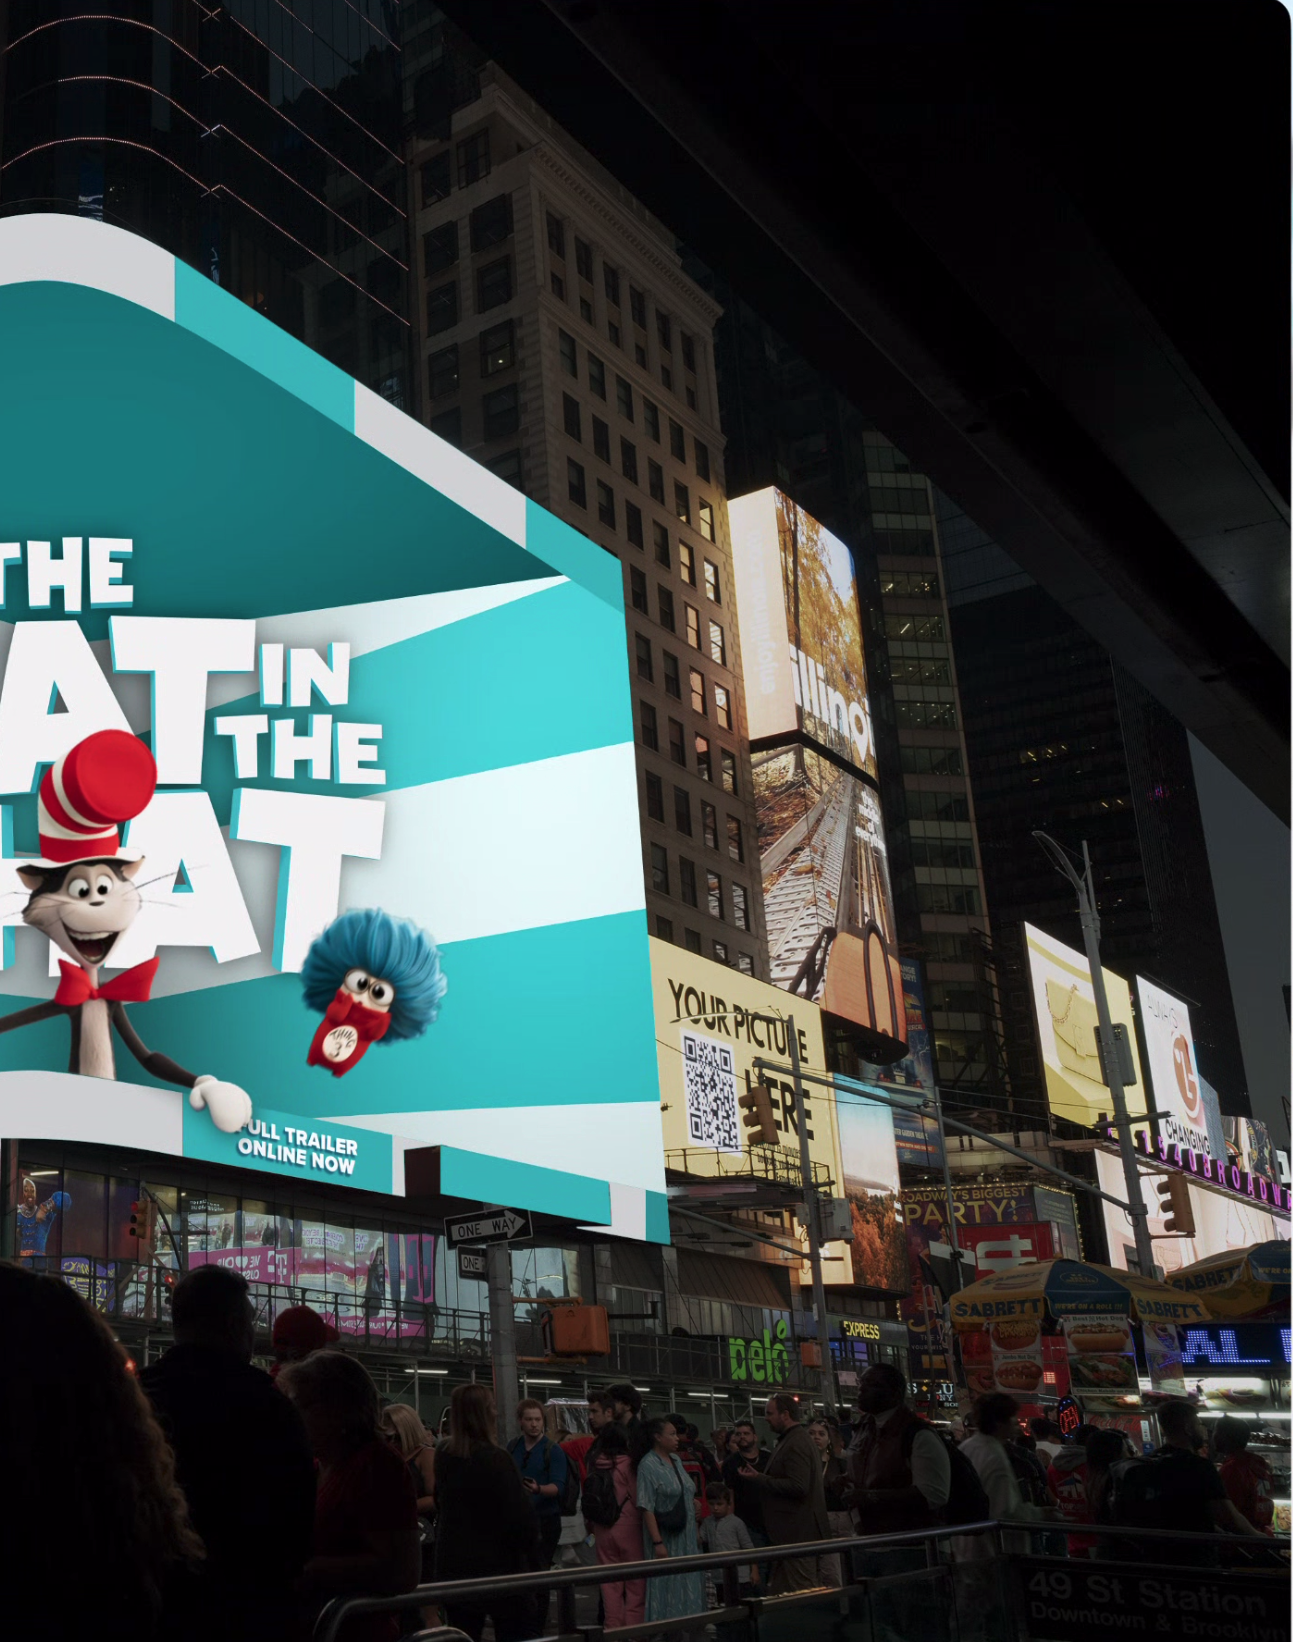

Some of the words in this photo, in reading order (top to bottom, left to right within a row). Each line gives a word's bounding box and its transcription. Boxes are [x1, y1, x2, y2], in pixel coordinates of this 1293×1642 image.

[258, 642, 351, 707] IN
[213, 714, 387, 785] THE
[667, 977, 732, 1037] YOUR
[732, 1003, 809, 1064] PICTUE
[244, 1119, 280, 1140] ULL
[284, 1126, 358, 1156] TRAILER
[237, 1137, 307, 1166] ONLINE
[312, 1151, 356, 1175] NOW
[972, 1187, 1027, 1200] BIGGEST
[905, 1199, 1020, 1226] PARTY!
[458, 1222, 482, 1238] ONE
[491, 1217, 518, 1233] WAY
[463, 1257, 480, 1270] ONE
[953, 1299, 1041, 1318] SABRETT
[1138, 1299, 1204, 1319] SABRETT
[843, 1320, 880, 1340] EXPRESS
[1059, 1405, 1080, 1434] OPEN
[1027, 1571, 1073, 1599] 49
[1086, 1574, 1125, 1604] St
[1138, 1579, 1268, 1618] Station
[1030, 1601, 1146, 1630] Downtown
[1157, 1613, 1172, 1632] &
